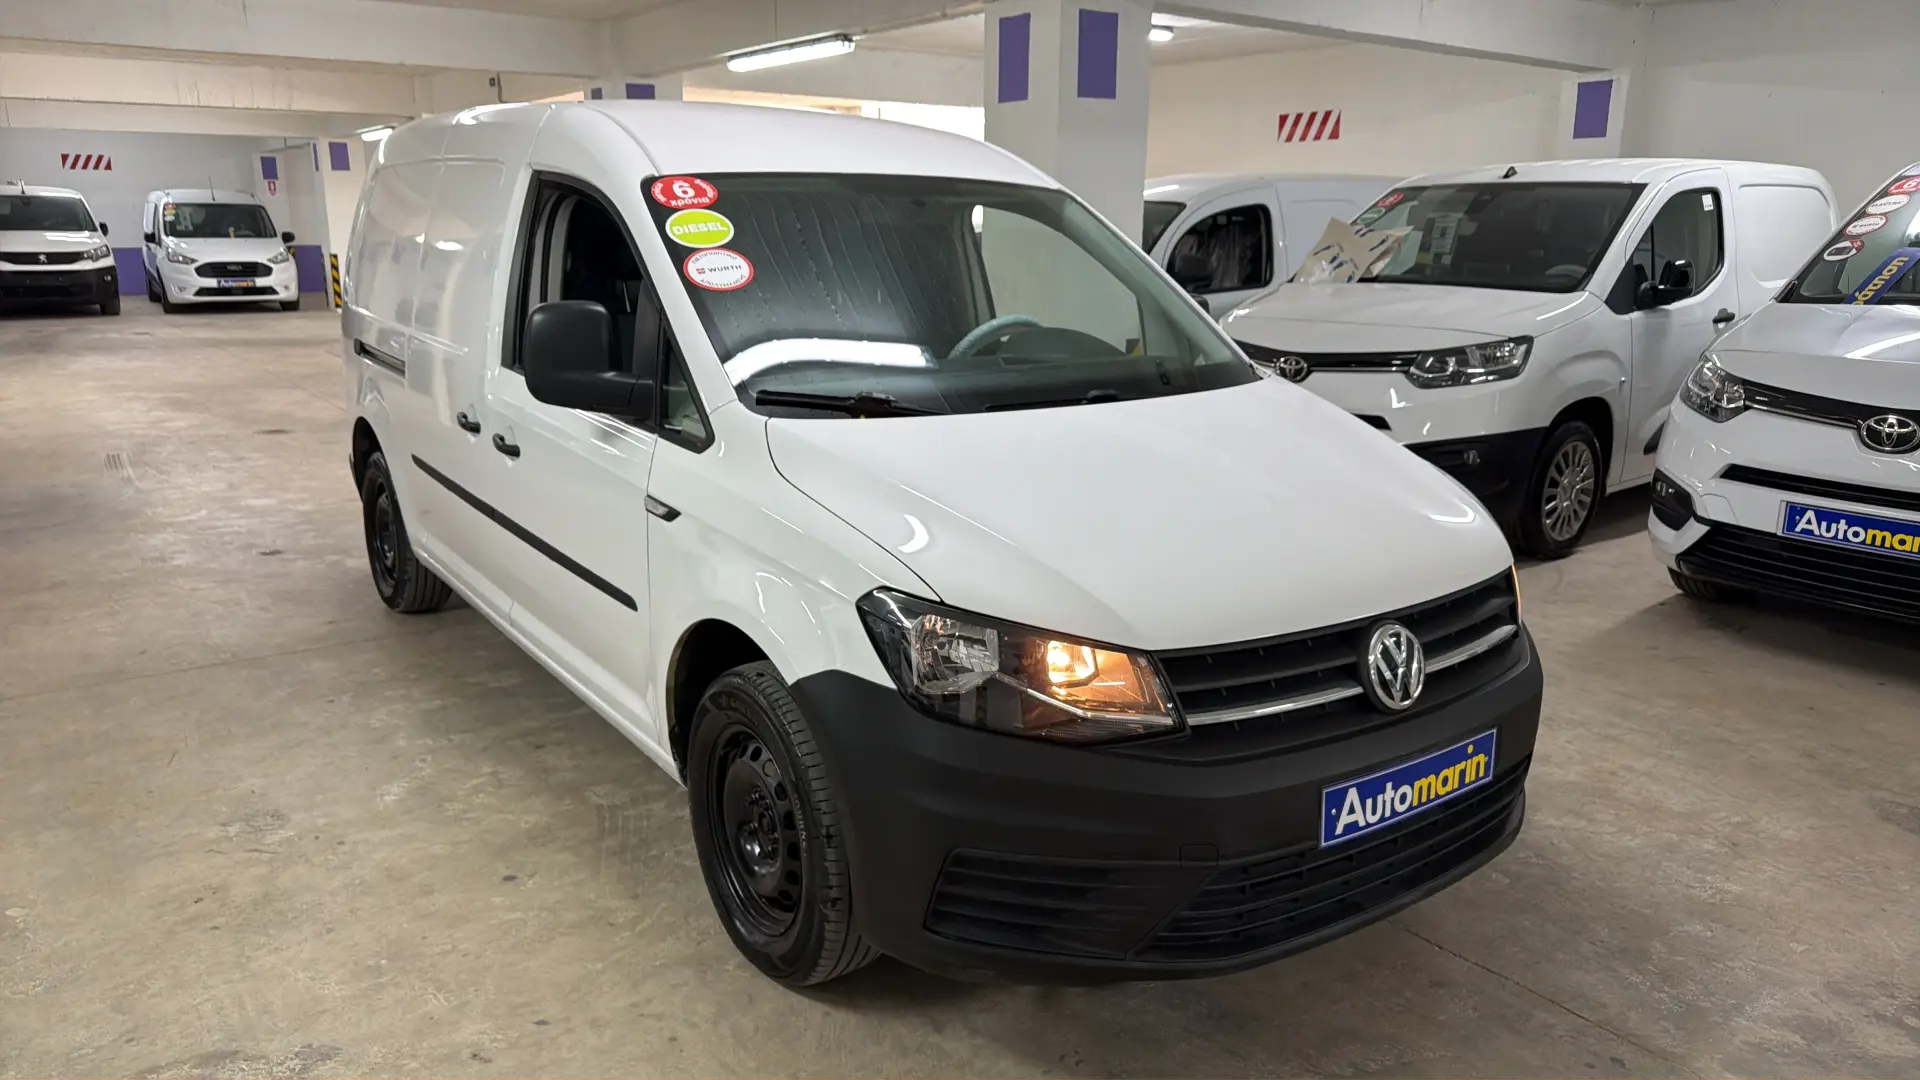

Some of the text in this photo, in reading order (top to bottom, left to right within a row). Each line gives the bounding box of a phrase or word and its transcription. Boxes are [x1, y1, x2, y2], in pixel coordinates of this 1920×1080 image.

[672, 181, 695, 198] 6
[672, 222, 728, 235] DIESEL
[1335, 744, 1486, 836] Automarin
